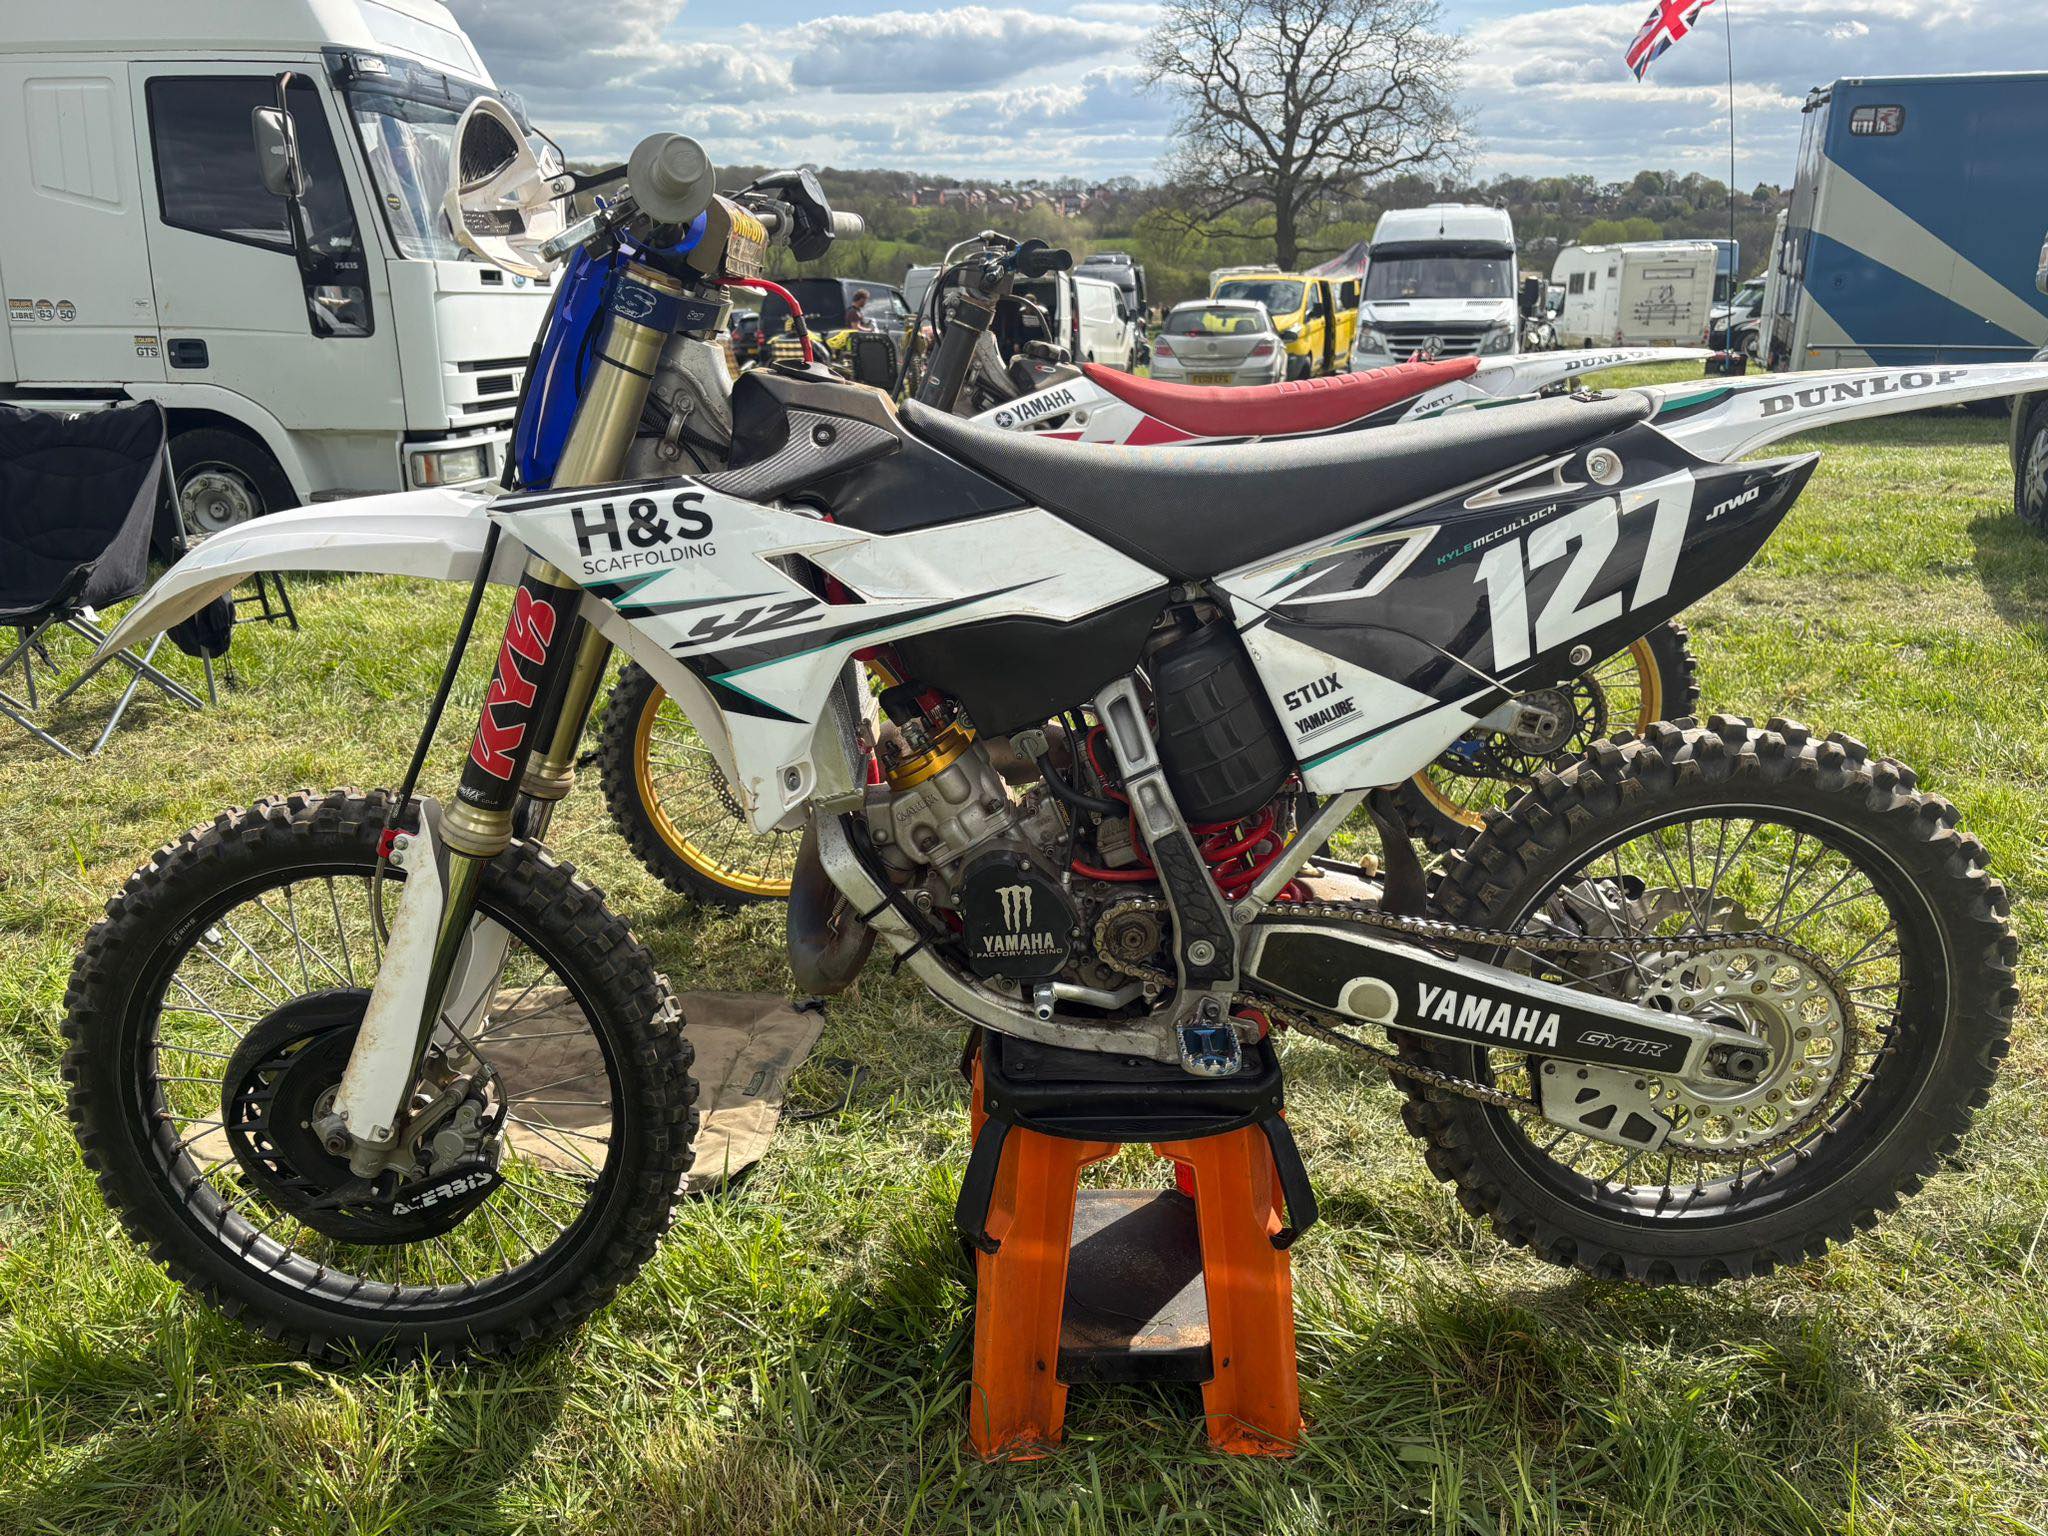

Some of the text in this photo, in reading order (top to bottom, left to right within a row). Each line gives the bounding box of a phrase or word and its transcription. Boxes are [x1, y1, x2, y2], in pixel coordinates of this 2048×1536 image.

[11, 311, 34, 320] LIBRE
[136, 346, 159, 357] GTS
[1010, 388, 1076, 421] YAMAHA
[1414, 392, 1454, 415] EVETT
[1759, 370, 1968, 418] DUNLOP
[570, 492, 714, 557] H&S
[583, 542, 717, 575] SCAFFOLDING
[1473, 468, 1696, 673] 127
[470, 585, 556, 780] KYB
[1283, 672, 1343, 712] STUX
[1294, 696, 1356, 735] YAMALUBE
[976, 947, 1063, 959] FACTORY RACING
[982, 932, 1055, 953] YAMAHA
[1416, 982, 1561, 1048] YAMAHA
[1577, 1030, 1670, 1057] GYTR
